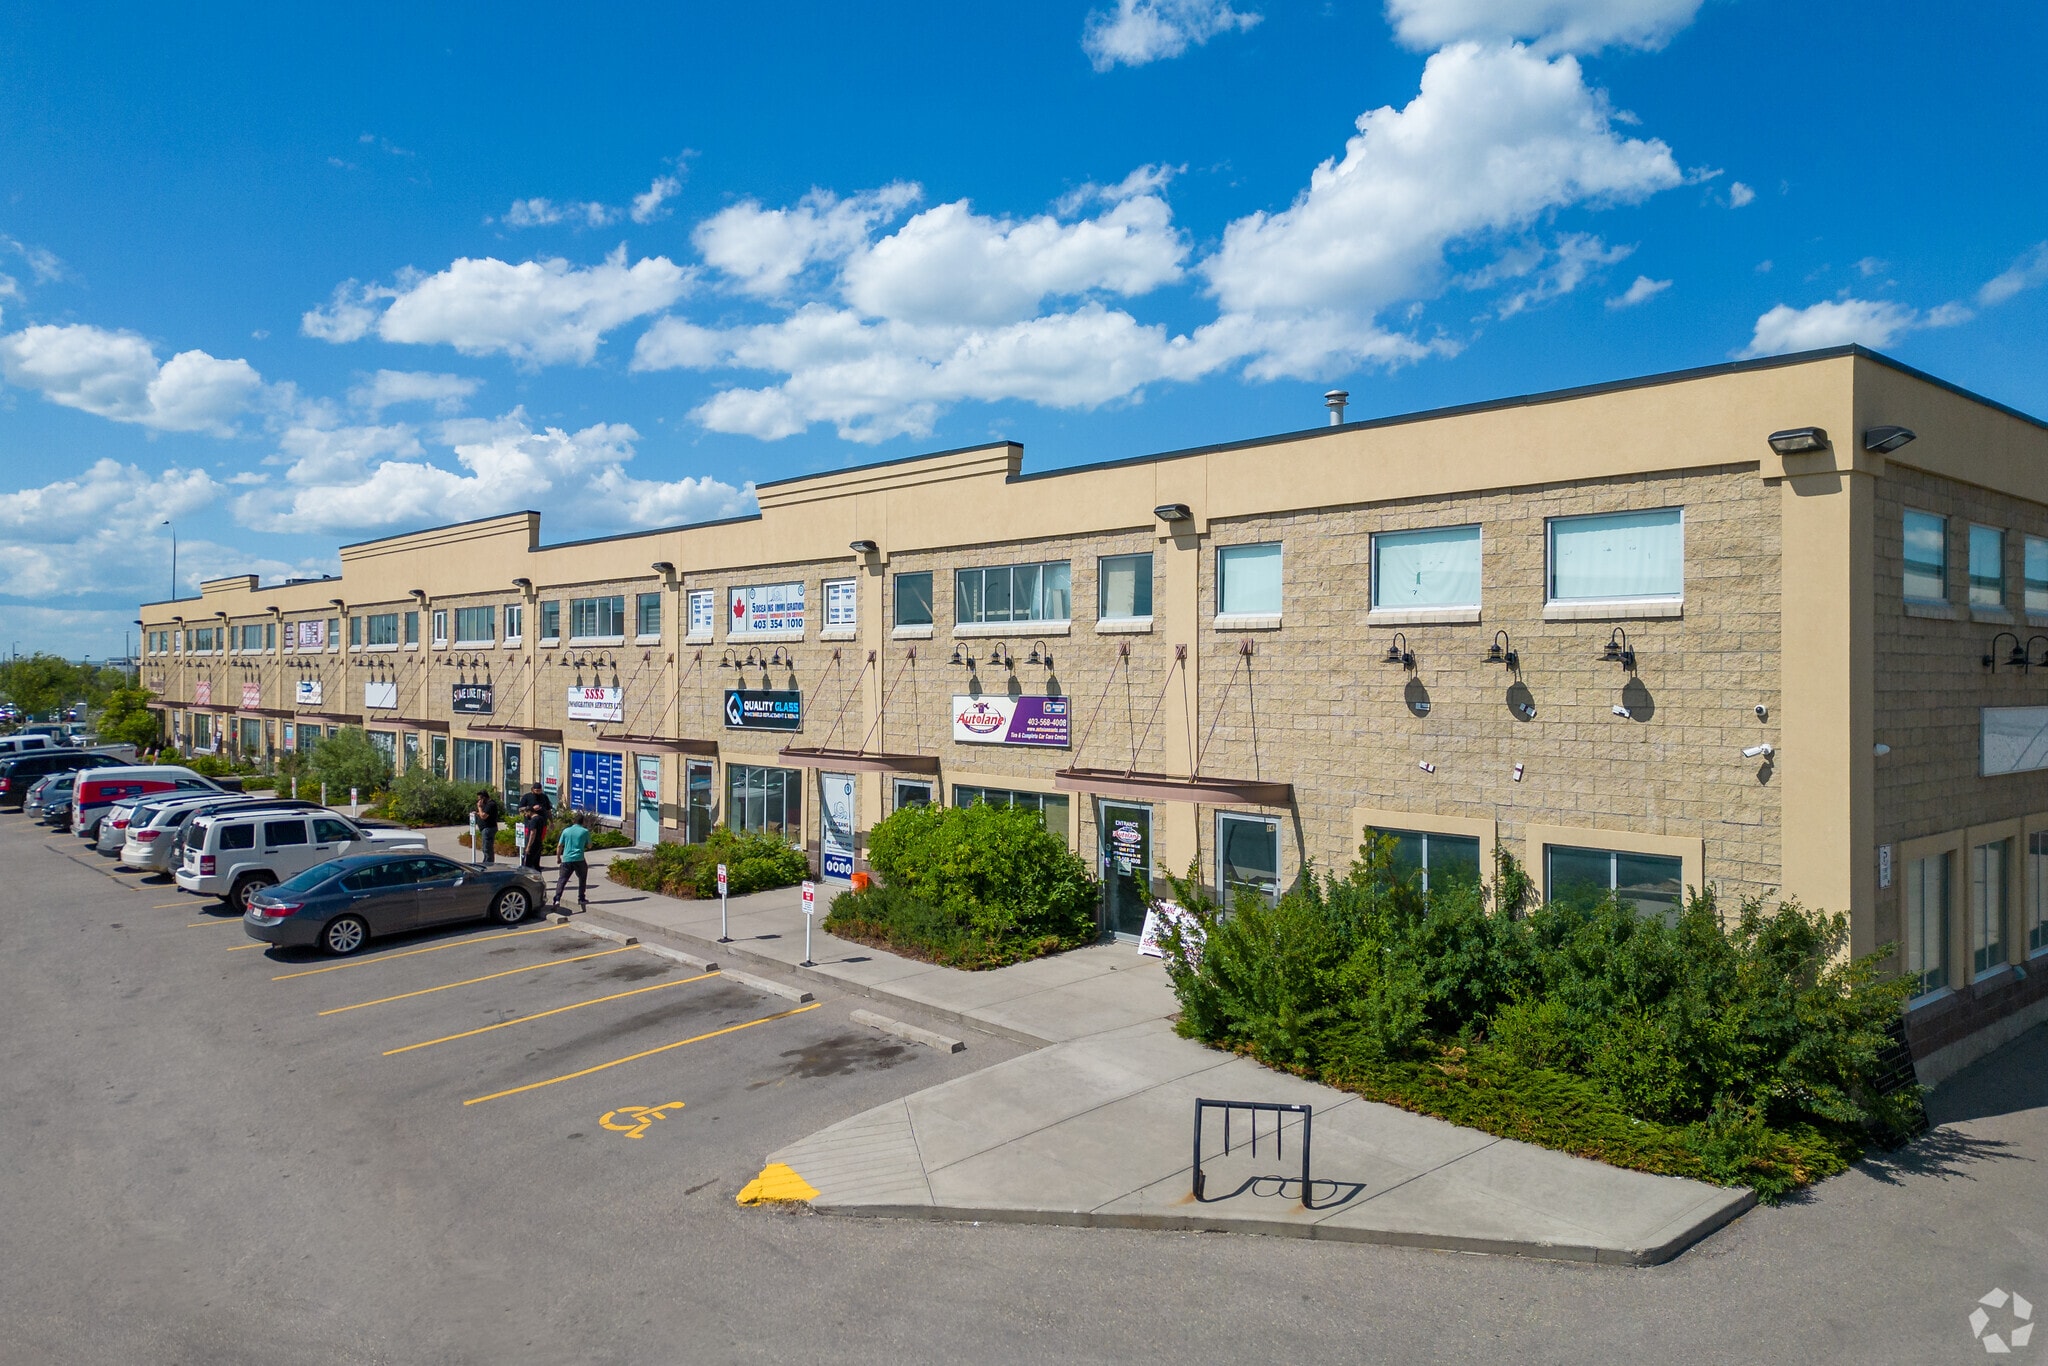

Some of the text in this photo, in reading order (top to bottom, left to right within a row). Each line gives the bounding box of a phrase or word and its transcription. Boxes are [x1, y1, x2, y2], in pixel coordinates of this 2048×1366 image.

[753, 618, 803, 629] 403 354 1010
[584, 688, 605, 700] SSSS
[743, 700, 799, 713] QUALITY GLASS
[956, 713, 1005, 726] Autolane
[1115, 820, 1139, 828] ENTRANCE
